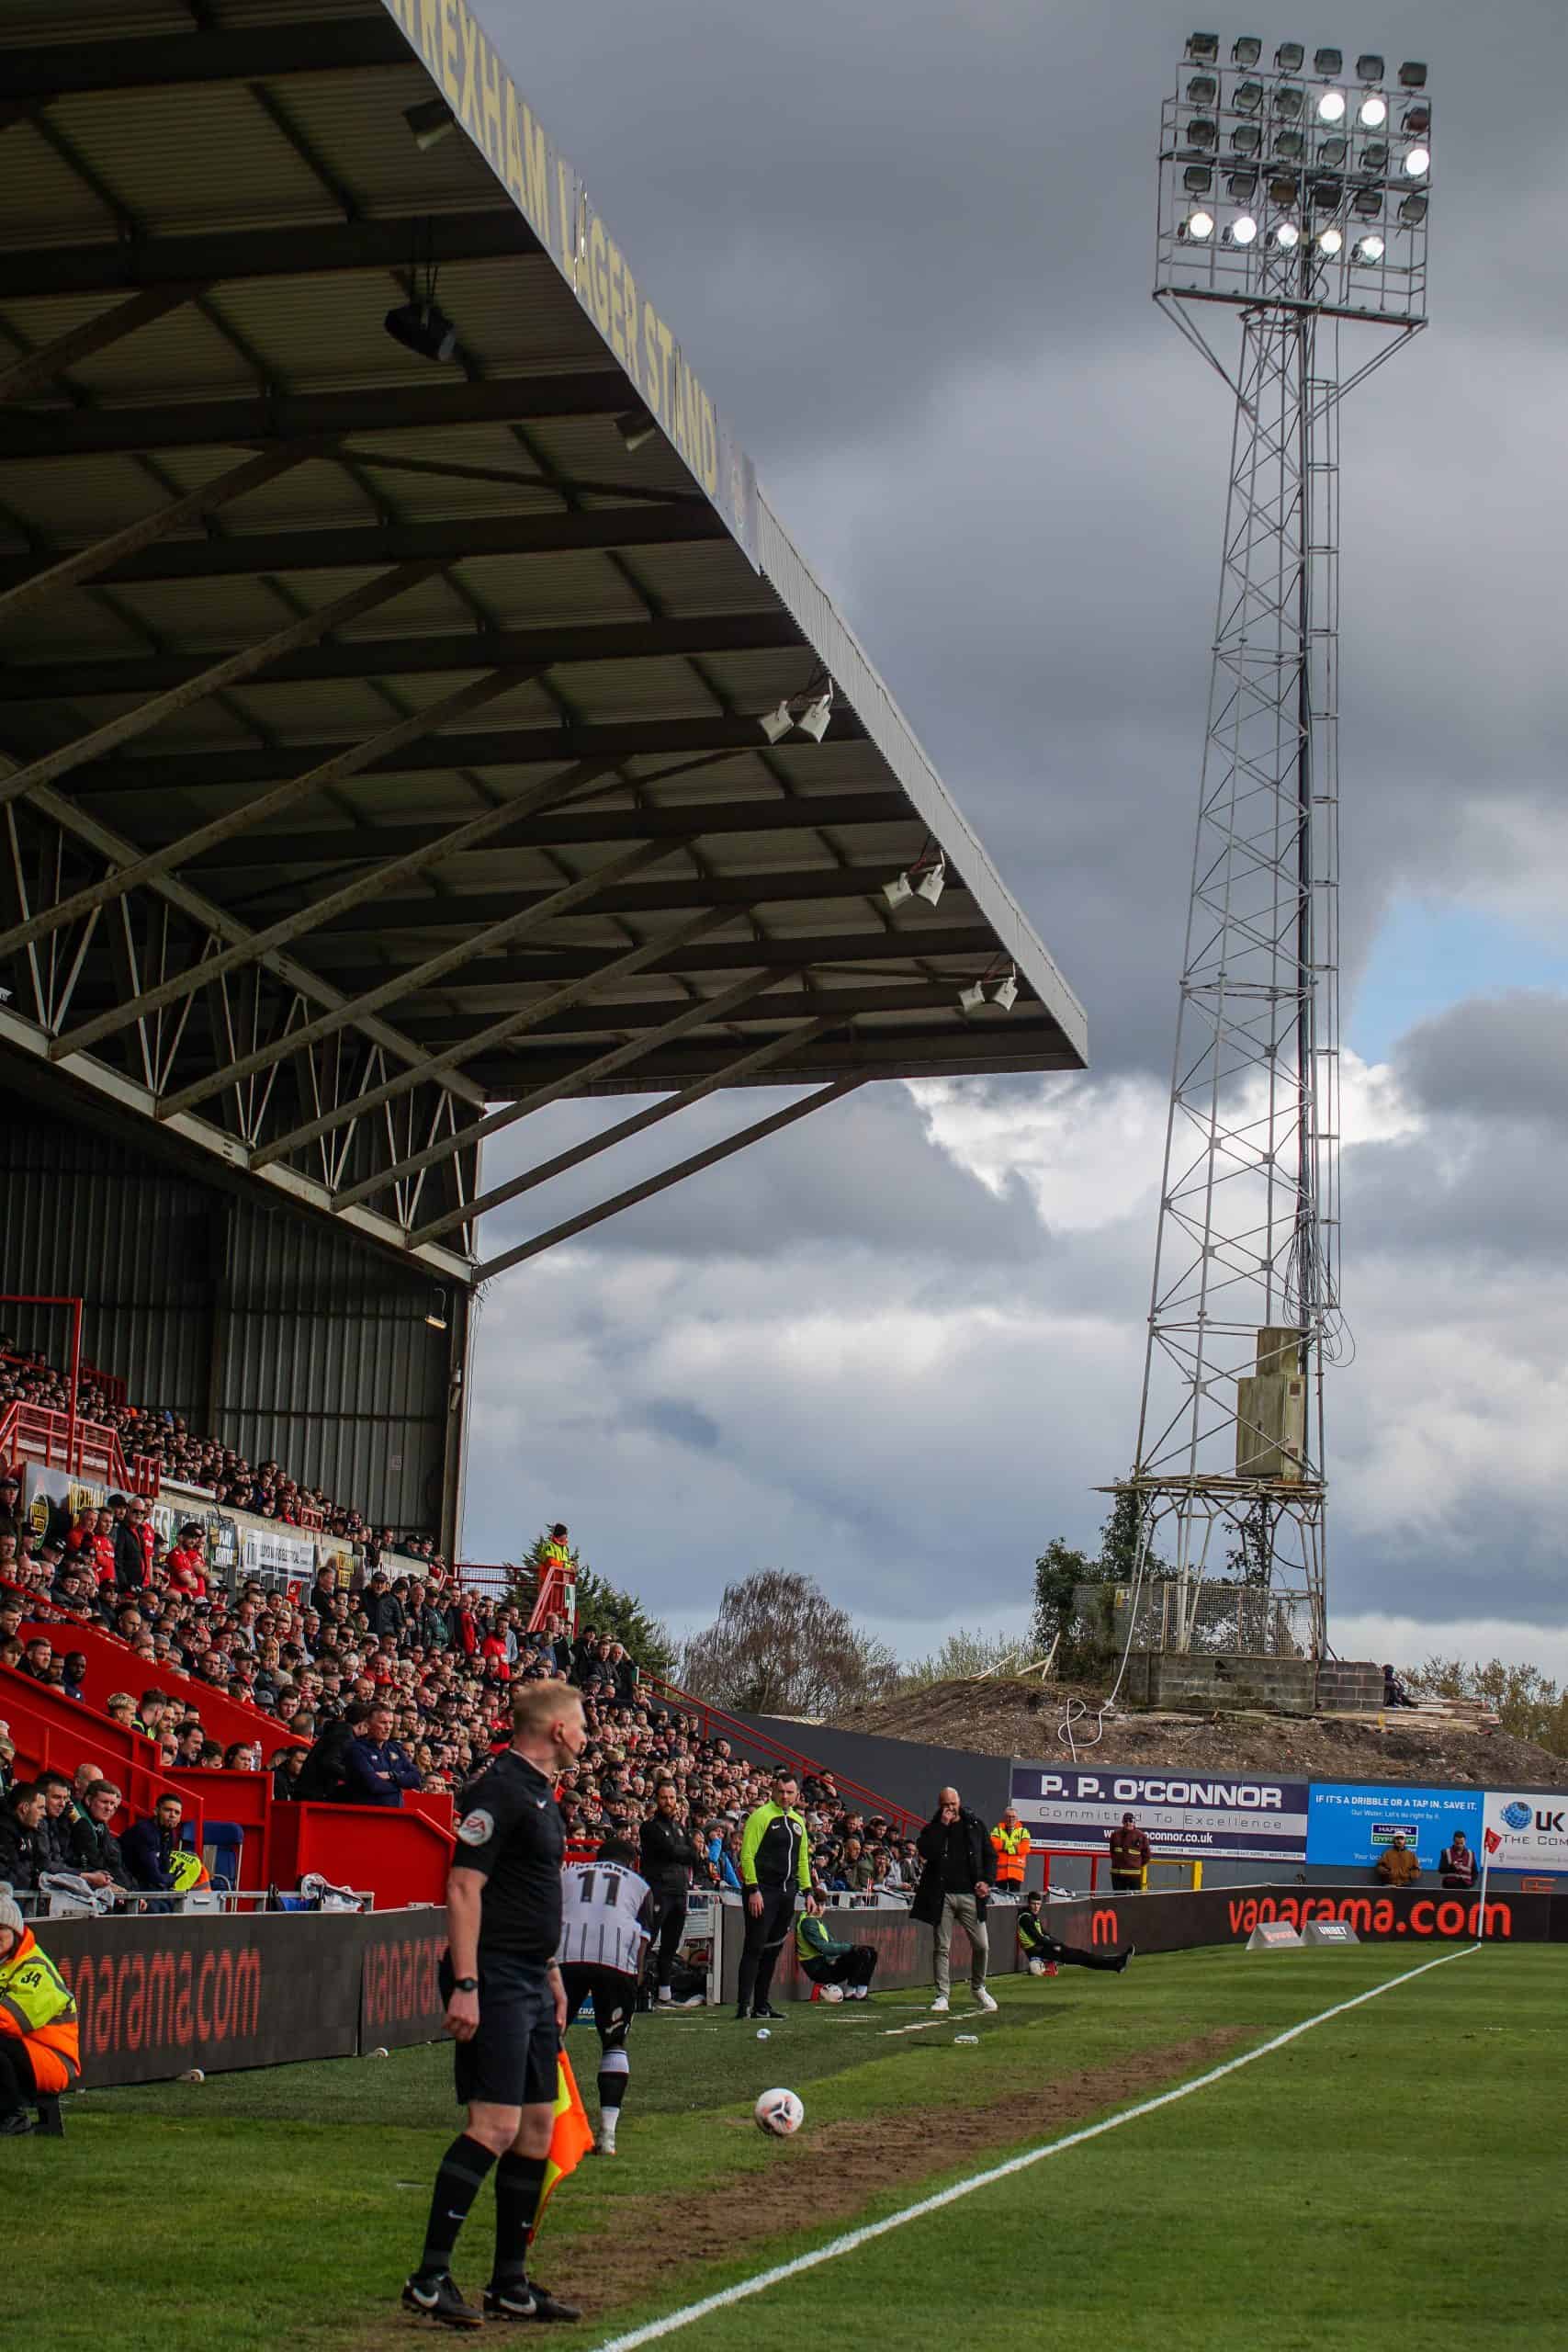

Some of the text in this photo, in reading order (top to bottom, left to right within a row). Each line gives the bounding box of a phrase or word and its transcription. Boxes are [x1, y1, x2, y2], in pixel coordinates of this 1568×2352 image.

[393, 0, 717, 497] REXHAM LAGER STAND
[1040, 1774, 1282, 1809] P. P. O'CONNOR
[1315, 1794, 1478, 1811] IF IT'S A DRIBBLE OR A TAP IN. SAVE IT.
[1039, 1805, 1284, 1830] Committd To Excellence
[1535, 1810, 1565, 1833] UK
[1103, 1829, 1213, 1844] woconnor.co.uk
[1501, 1833, 1529, 1846] THE
[577, 1869, 622, 1907] 11
[1227, 1895, 1513, 1939] vanarama.com
[20, 1970, 42, 1989] 34
[60, 1947, 261, 2058] narama.com
